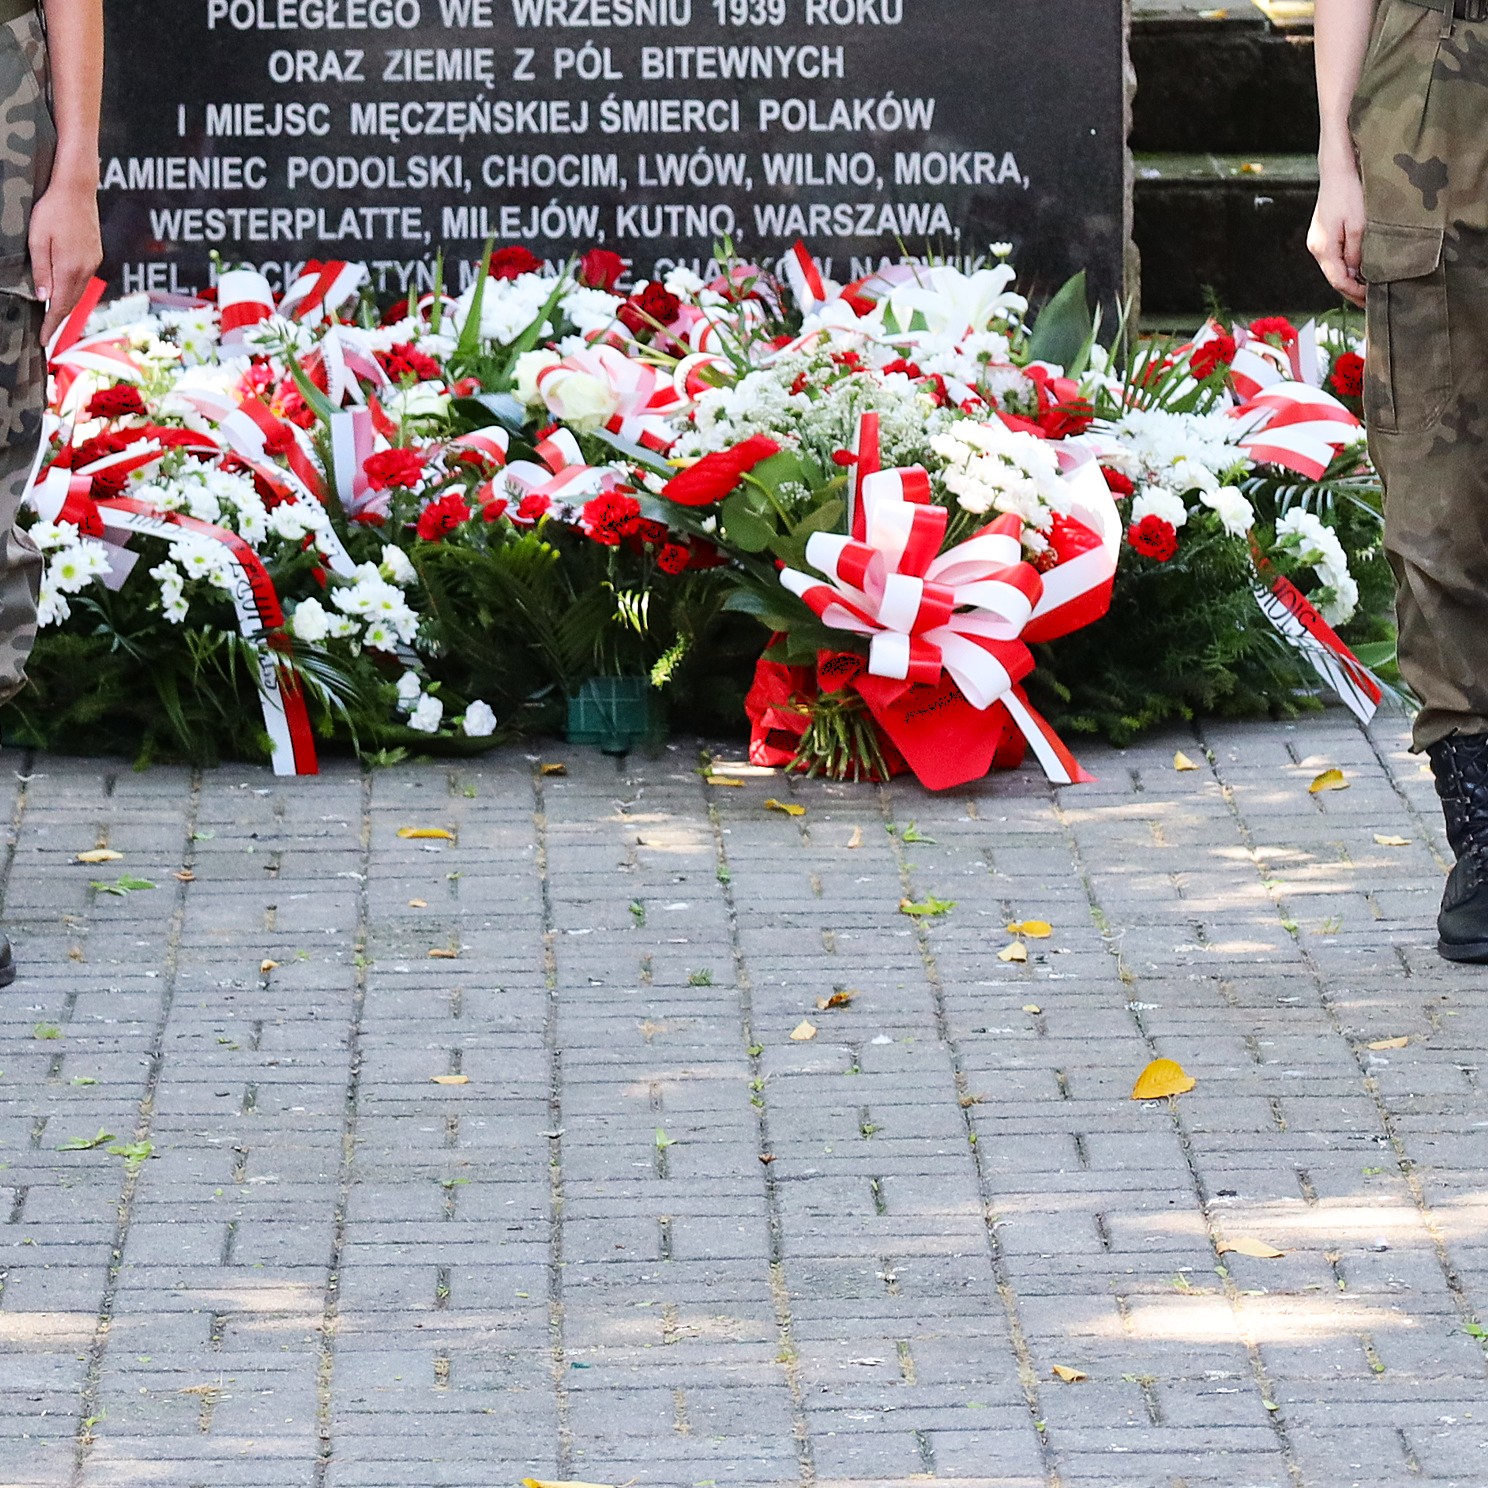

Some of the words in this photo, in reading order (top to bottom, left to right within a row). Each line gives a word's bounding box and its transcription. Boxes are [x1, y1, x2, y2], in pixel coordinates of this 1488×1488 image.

[268, 48, 366, 83] ORAZ
[382, 47, 496, 91] ZIEMIĘ
[512, 47, 536, 82] Z
[553, 39, 624, 81] PÓL
[641, 44, 845, 80] BITEWNYCH
[177, 103, 186, 137] I
[206, 102, 331, 137] MIEJSC
[350, 93, 589, 143] MĘCZEŃSKIEJ
[599, 92, 740, 134] ŚMIERCI
[759, 90, 936, 134] POLAKÓW
[96, 155, 267, 190] AMIENIEC
[287, 154, 472, 194] PODOLSKI,
[481, 153, 628, 193] CHOCIM,
[638, 145, 753, 192] LWÓW,
[761, 151, 884, 192] WILNO,
[894, 150, 1031, 191] MOKRA,
[149, 206, 432, 244] WESTERPLATTE,
[441, 197, 605, 244] MILEJÓW,
[616, 203, 744, 241] KUTNO,
[753, 202, 961, 242] WARSZAWA,
